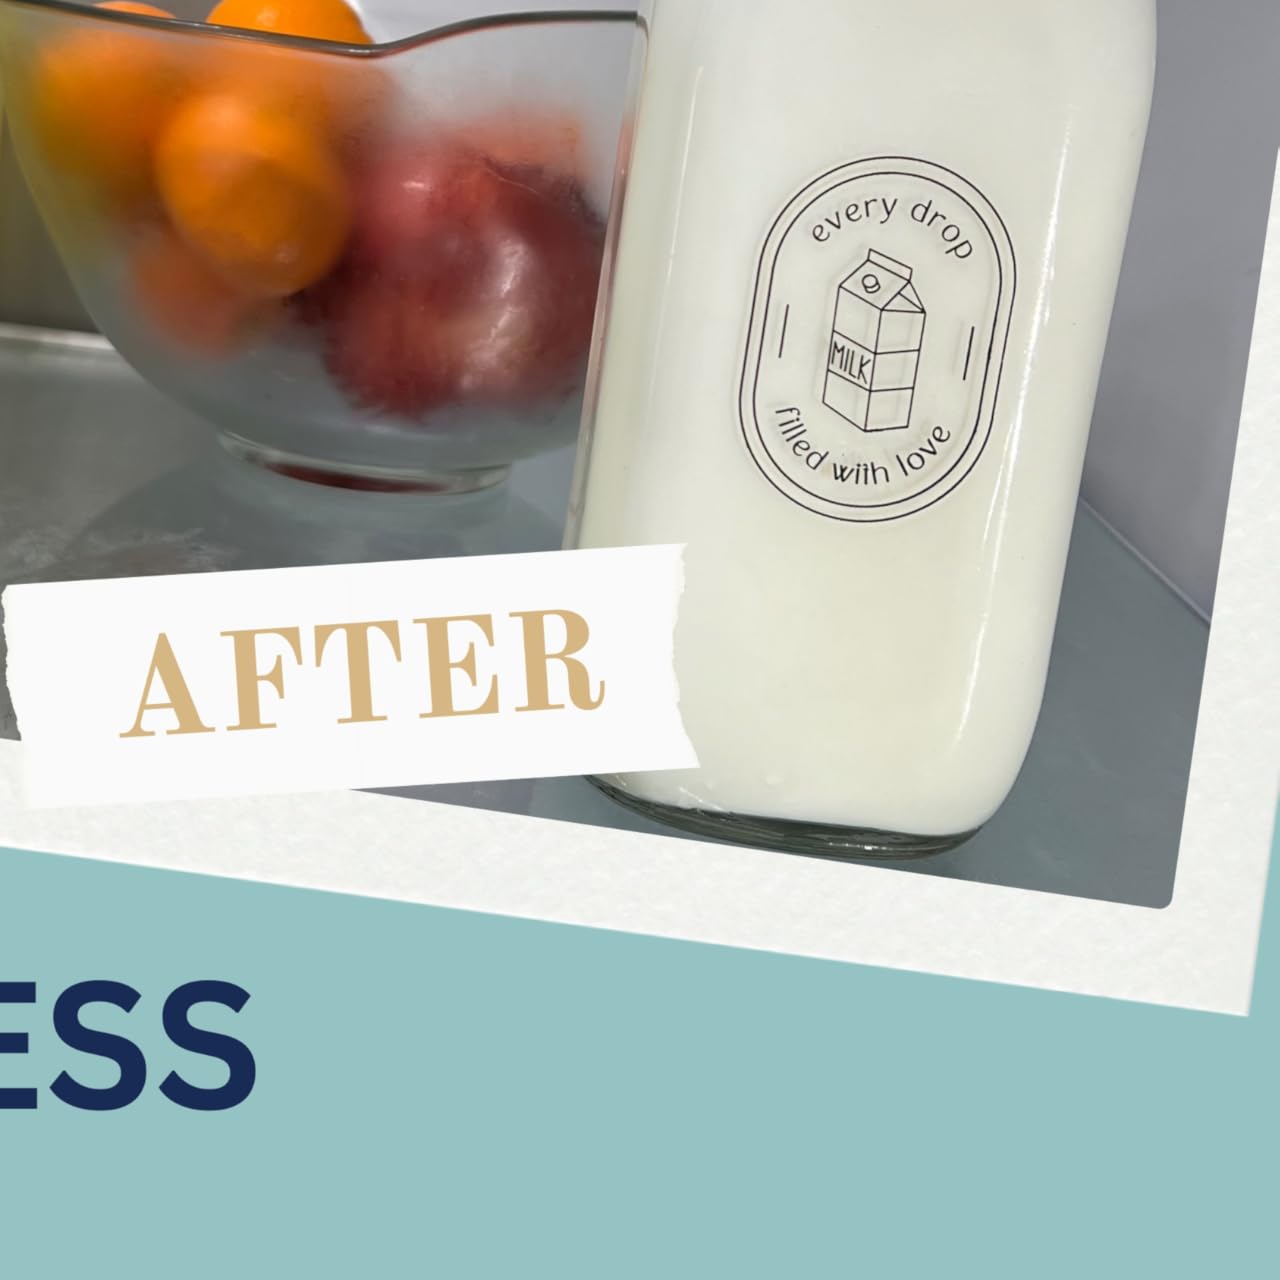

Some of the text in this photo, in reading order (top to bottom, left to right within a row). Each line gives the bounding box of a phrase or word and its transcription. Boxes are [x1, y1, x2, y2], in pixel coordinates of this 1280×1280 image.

[812, 198, 973, 259] every drop
[831, 341, 871, 384] MILK
[775, 407, 951, 485] filled with love
